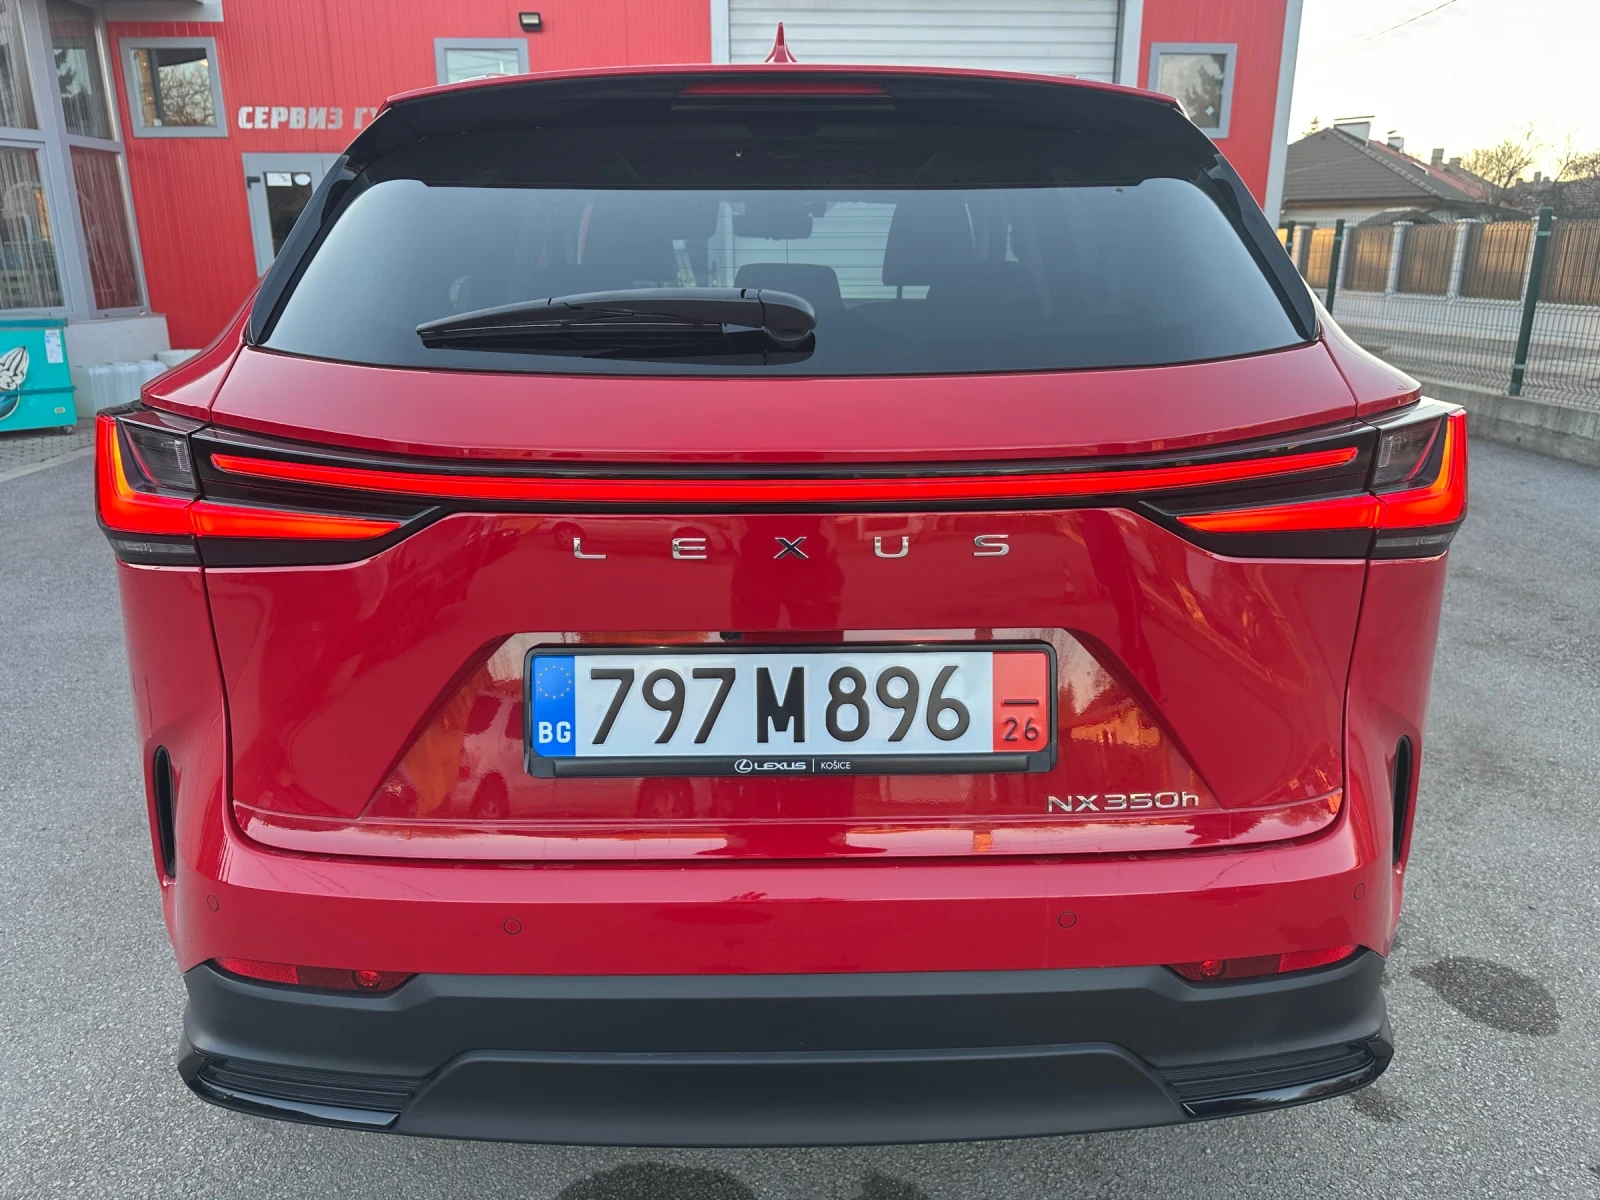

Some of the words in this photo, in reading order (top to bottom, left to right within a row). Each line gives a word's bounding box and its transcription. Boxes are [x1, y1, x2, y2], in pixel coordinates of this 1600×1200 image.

[237, 106, 343, 130] СЕРВИЗ
[573, 534, 1010, 560] LEXUS
[590, 667, 736, 744] 797
[756, 666, 805, 743] M
[825, 665, 970, 742] 896
[538, 721, 571, 744] BG
[1003, 717, 1040, 742] 26
[754, 761, 807, 770] LEXUS
[820, 759, 851, 770] KOŠICE
